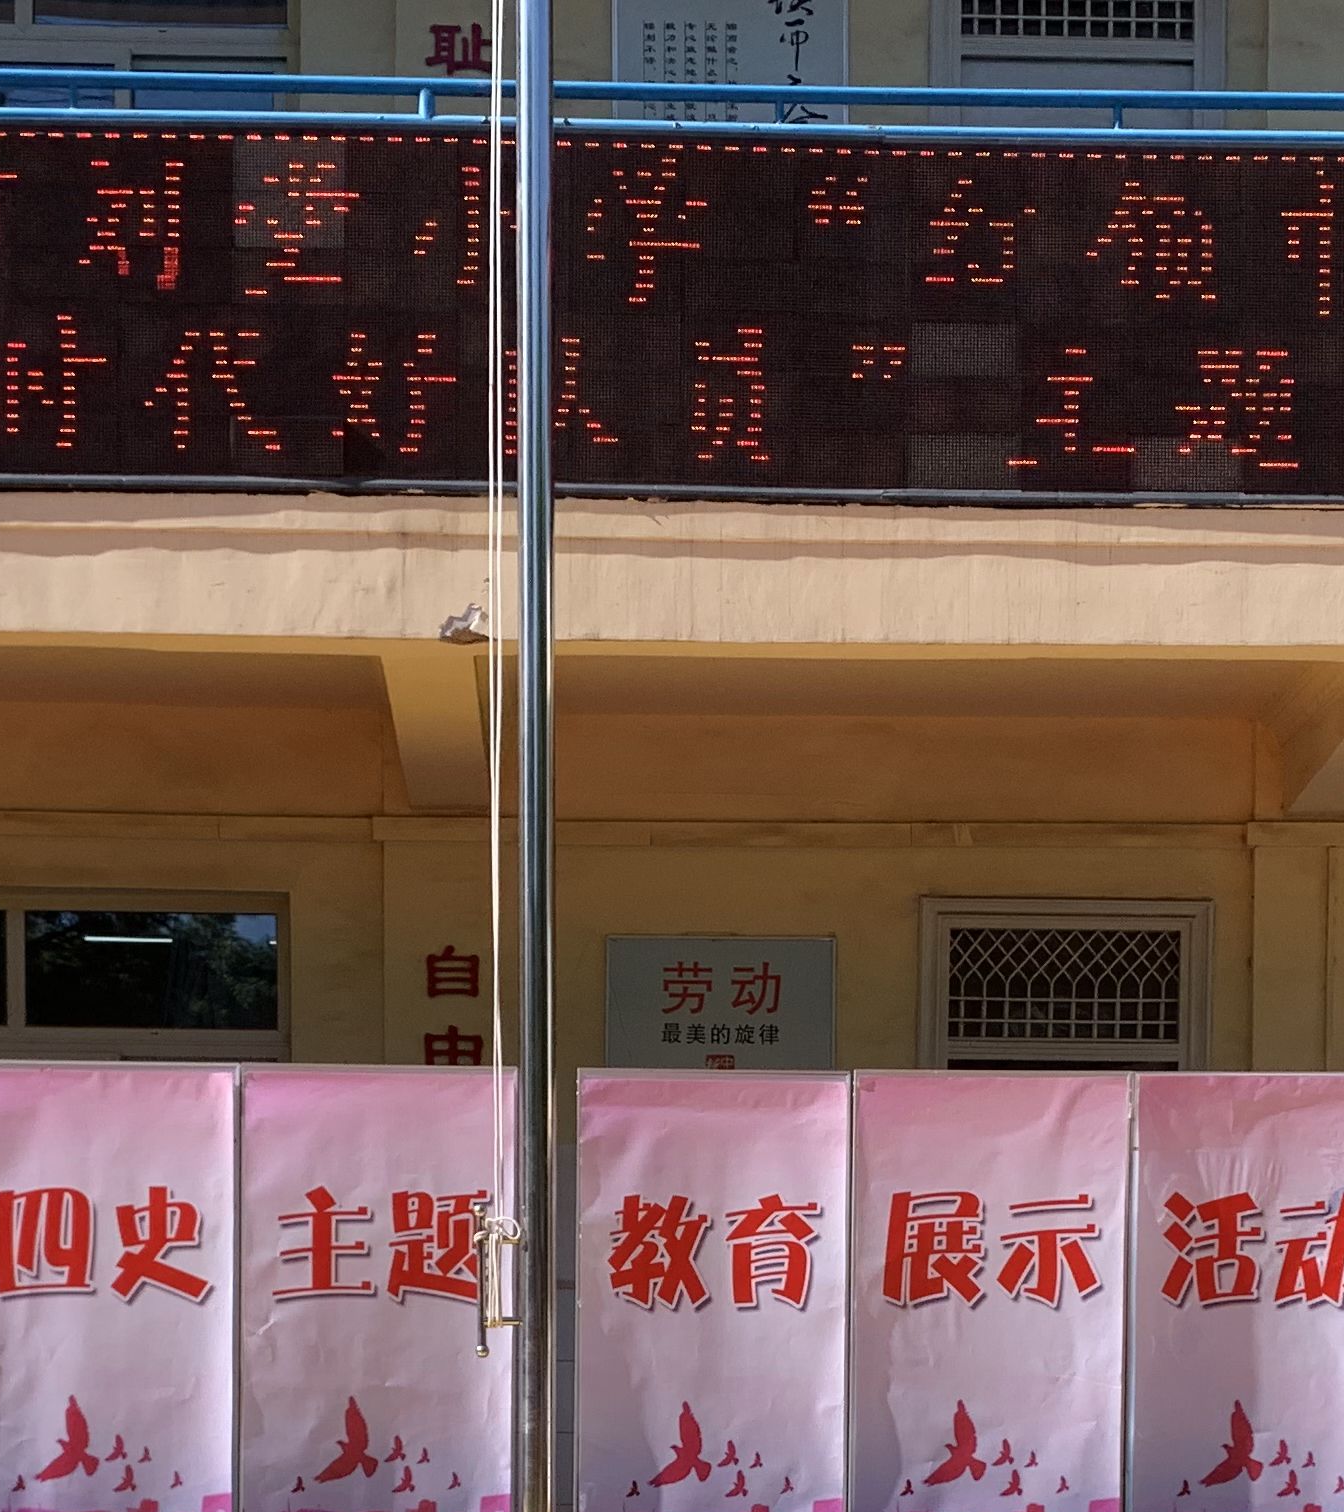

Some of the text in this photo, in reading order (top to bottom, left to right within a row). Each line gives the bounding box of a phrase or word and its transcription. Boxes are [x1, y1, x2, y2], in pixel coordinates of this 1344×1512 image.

[425, 22, 494, 75] 耻
[660, 961, 783, 1015] 劳动
[660, 1022, 782, 1046] 最美的旋律
[273, 1186, 494, 1304] 主题
[609, 1193, 825, 1309] 教育
[882, 1190, 1102, 1307] 展示
